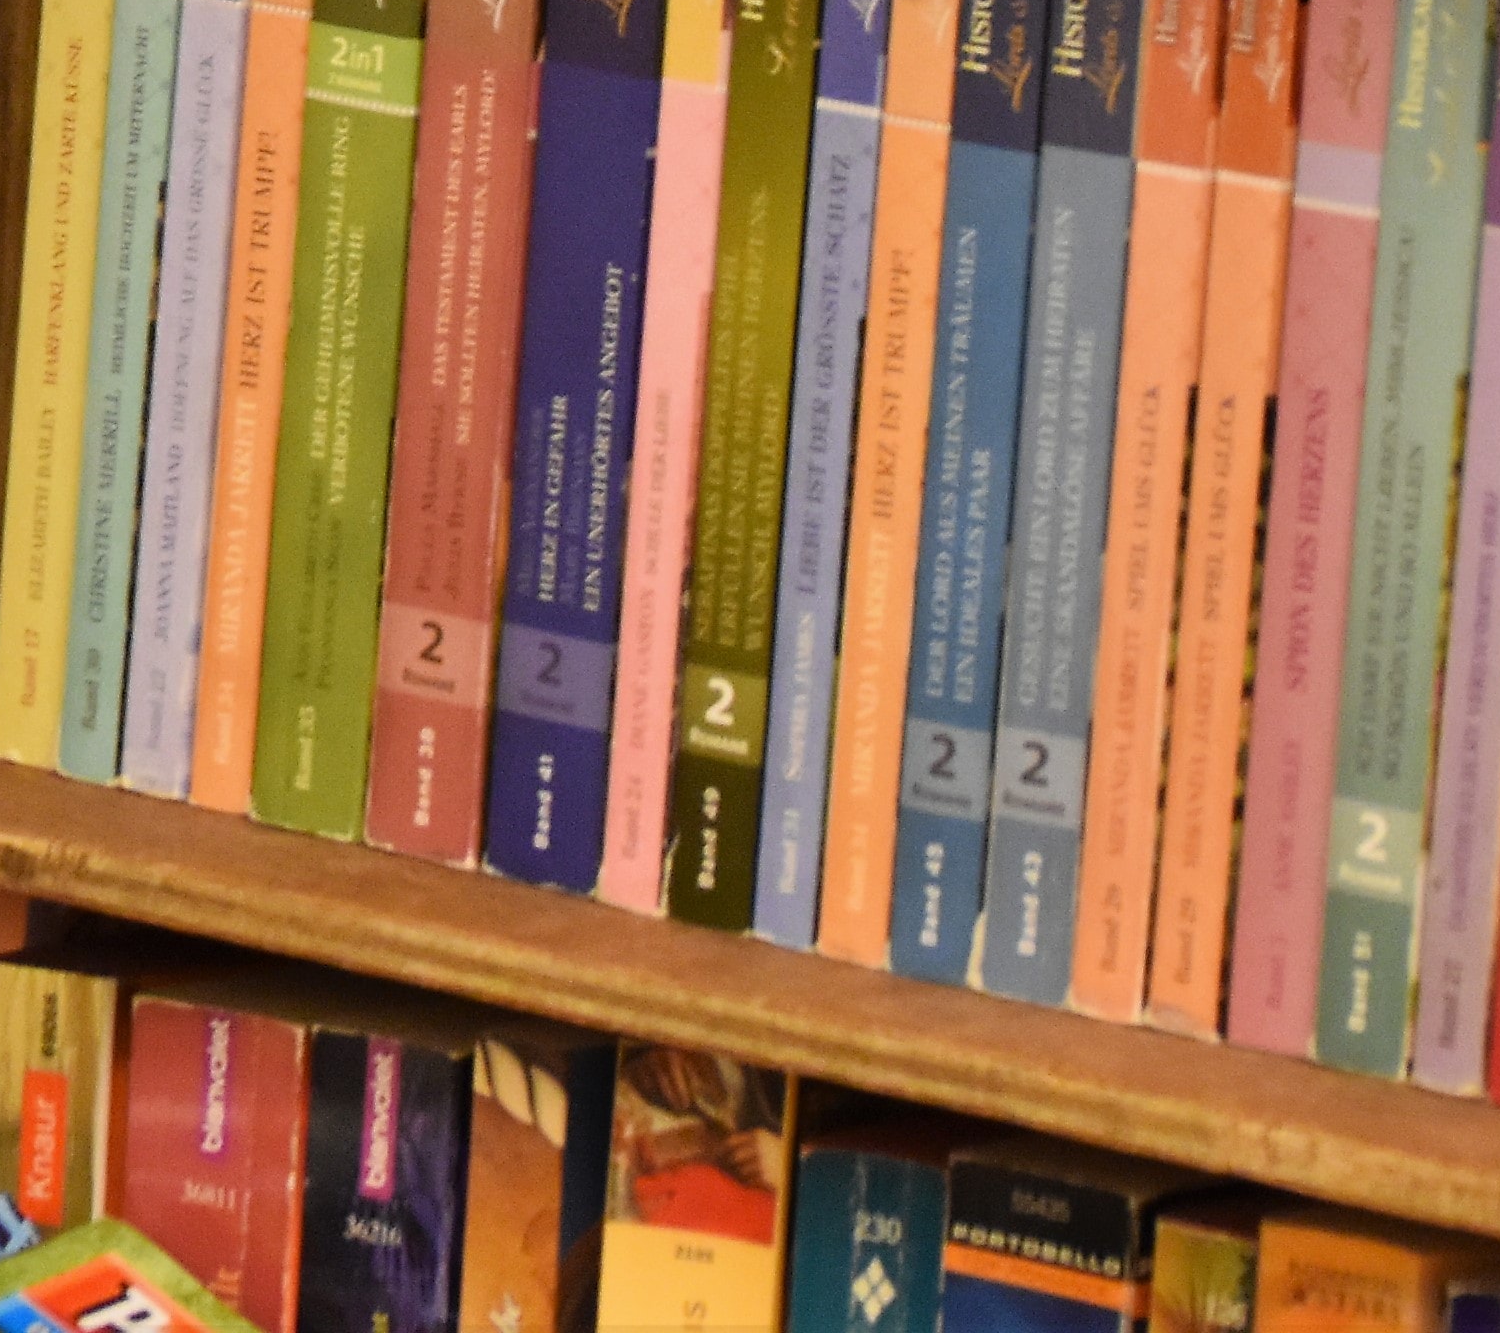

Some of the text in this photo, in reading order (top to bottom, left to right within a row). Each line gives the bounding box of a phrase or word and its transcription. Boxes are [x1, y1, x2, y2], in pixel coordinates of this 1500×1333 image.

[420, 620, 446, 665] 2
[537, 644, 562, 682] 2
[705, 677, 734, 726] 2
[928, 735, 956, 780] 2
[1356, 814, 1386, 861] 2
[203, 1018, 229, 1151] blanvalet
[368, 1050, 392, 1188] blanvalet
